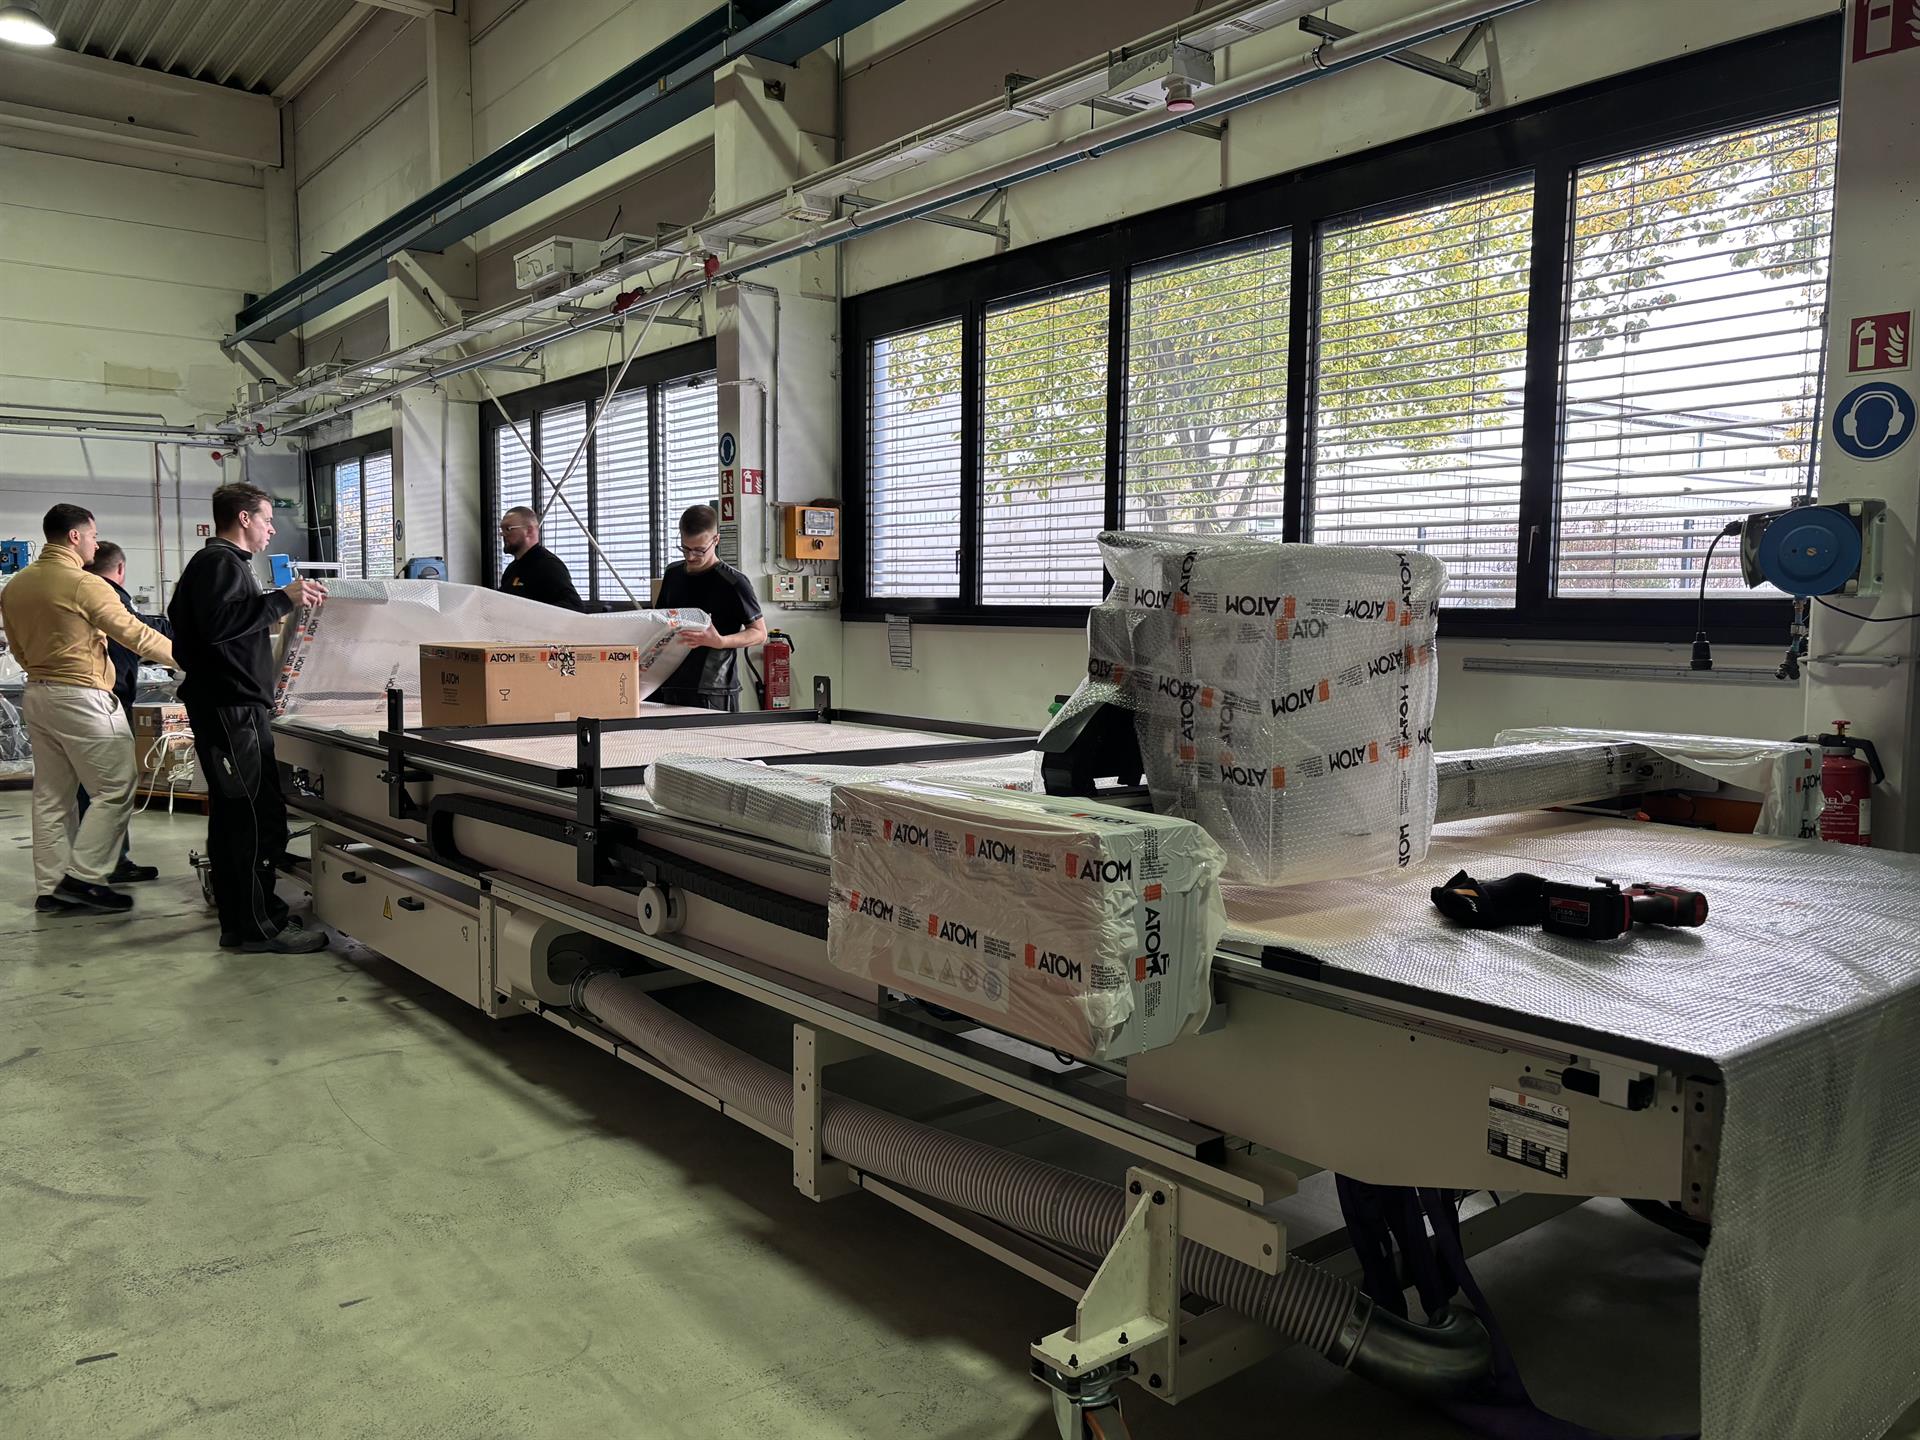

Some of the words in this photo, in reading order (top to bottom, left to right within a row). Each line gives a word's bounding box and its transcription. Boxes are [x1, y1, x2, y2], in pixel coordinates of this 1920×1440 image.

[1396, 553, 1411, 606] ATOM
[1135, 588, 1172, 609] ATOM
[1225, 595, 1281, 616] ATOM
[1344, 600, 1385, 619] ATOM
[490, 653, 516, 662] ATOM
[608, 652, 631, 661] ATOM
[1088, 658, 1114, 677] ATO
[1368, 649, 1402, 679] ATOM
[1271, 684, 1316, 718] ATOM
[1329, 745, 1366, 772] ATOM
[1221, 765, 1267, 787] ATOM
[831, 812, 846, 832] OM
[893, 824, 929, 848] ATOM
[978, 838, 1016, 865] ATOM
[1080, 858, 1132, 883] ATOM
[860, 896, 894, 922] ATOM
[940, 920, 978, 949] ATOM
[1038, 951, 1082, 983] ATOM
